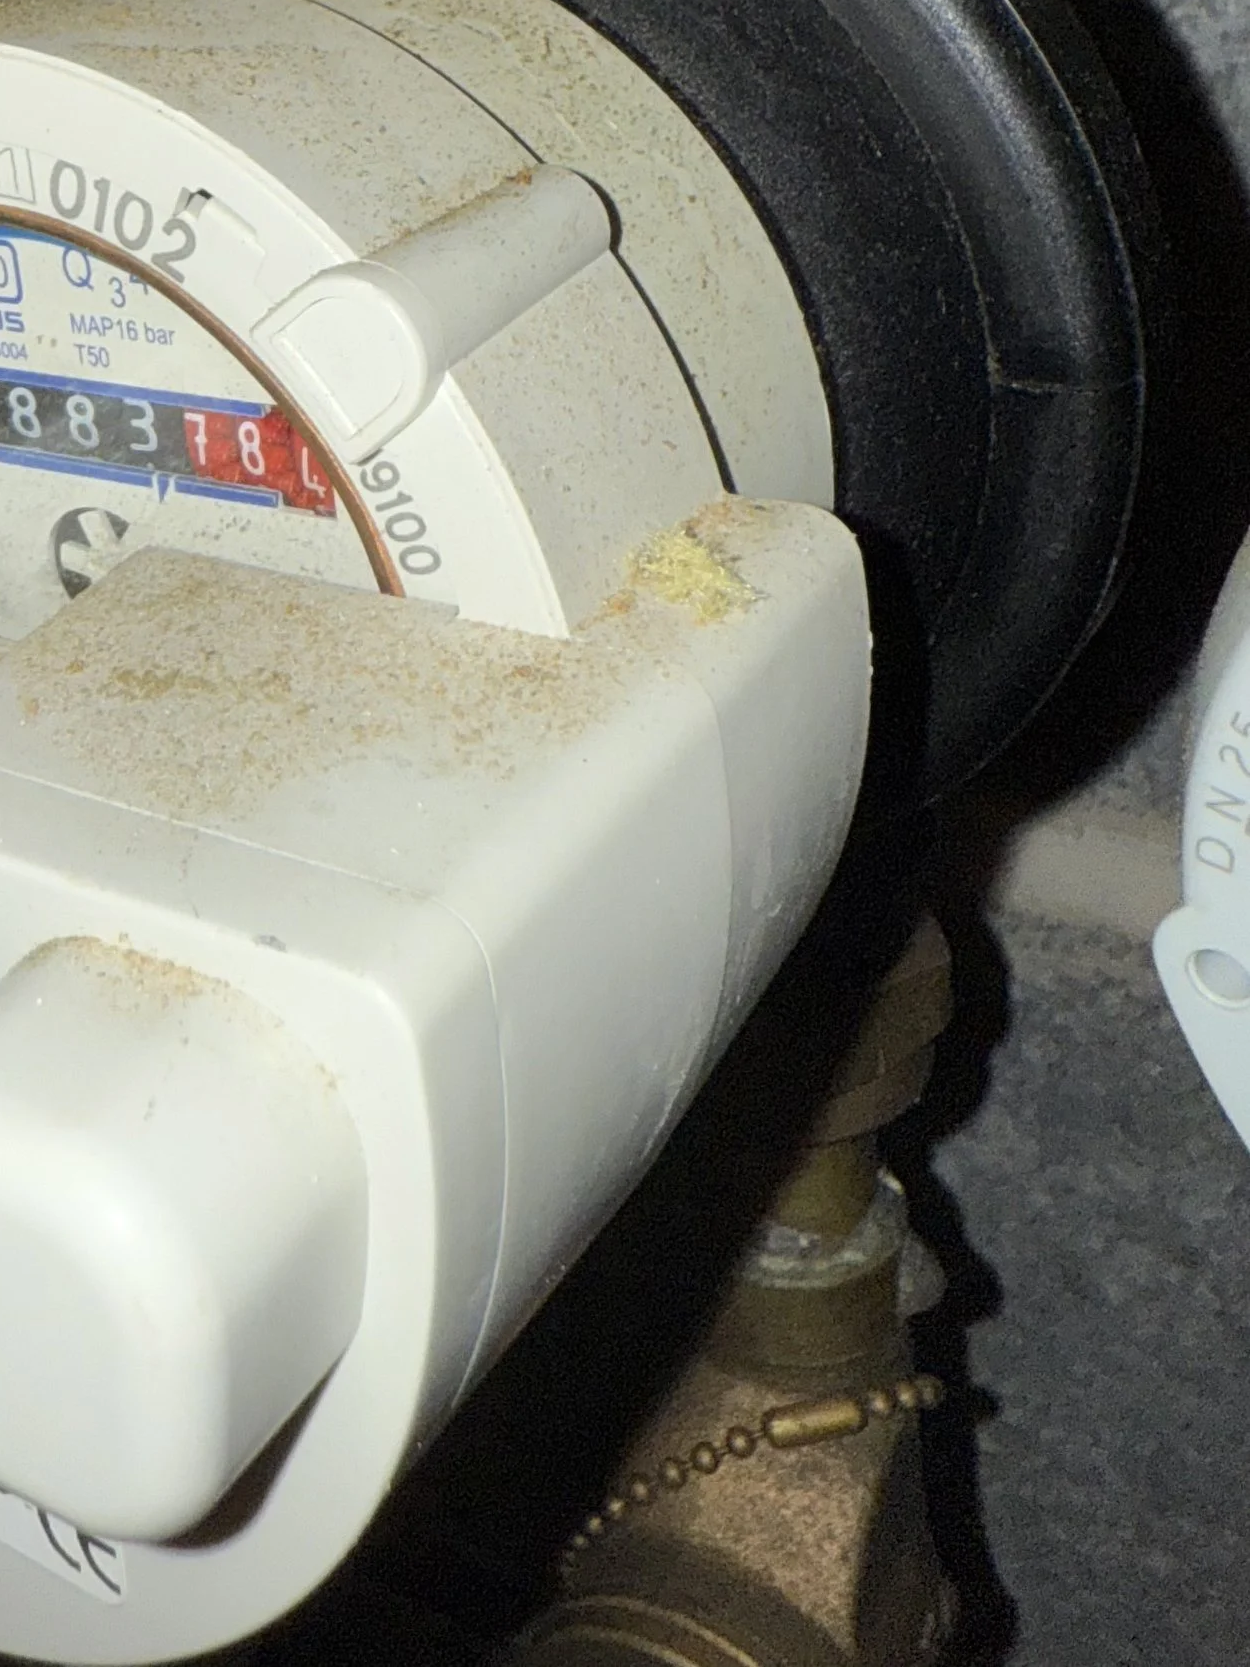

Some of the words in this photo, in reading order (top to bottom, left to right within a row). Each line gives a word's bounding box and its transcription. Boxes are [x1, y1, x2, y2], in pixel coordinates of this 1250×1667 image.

[49, 159, 197, 284] 0102
[143, 320, 177, 346] bar
[73, 343, 111, 369] T50
